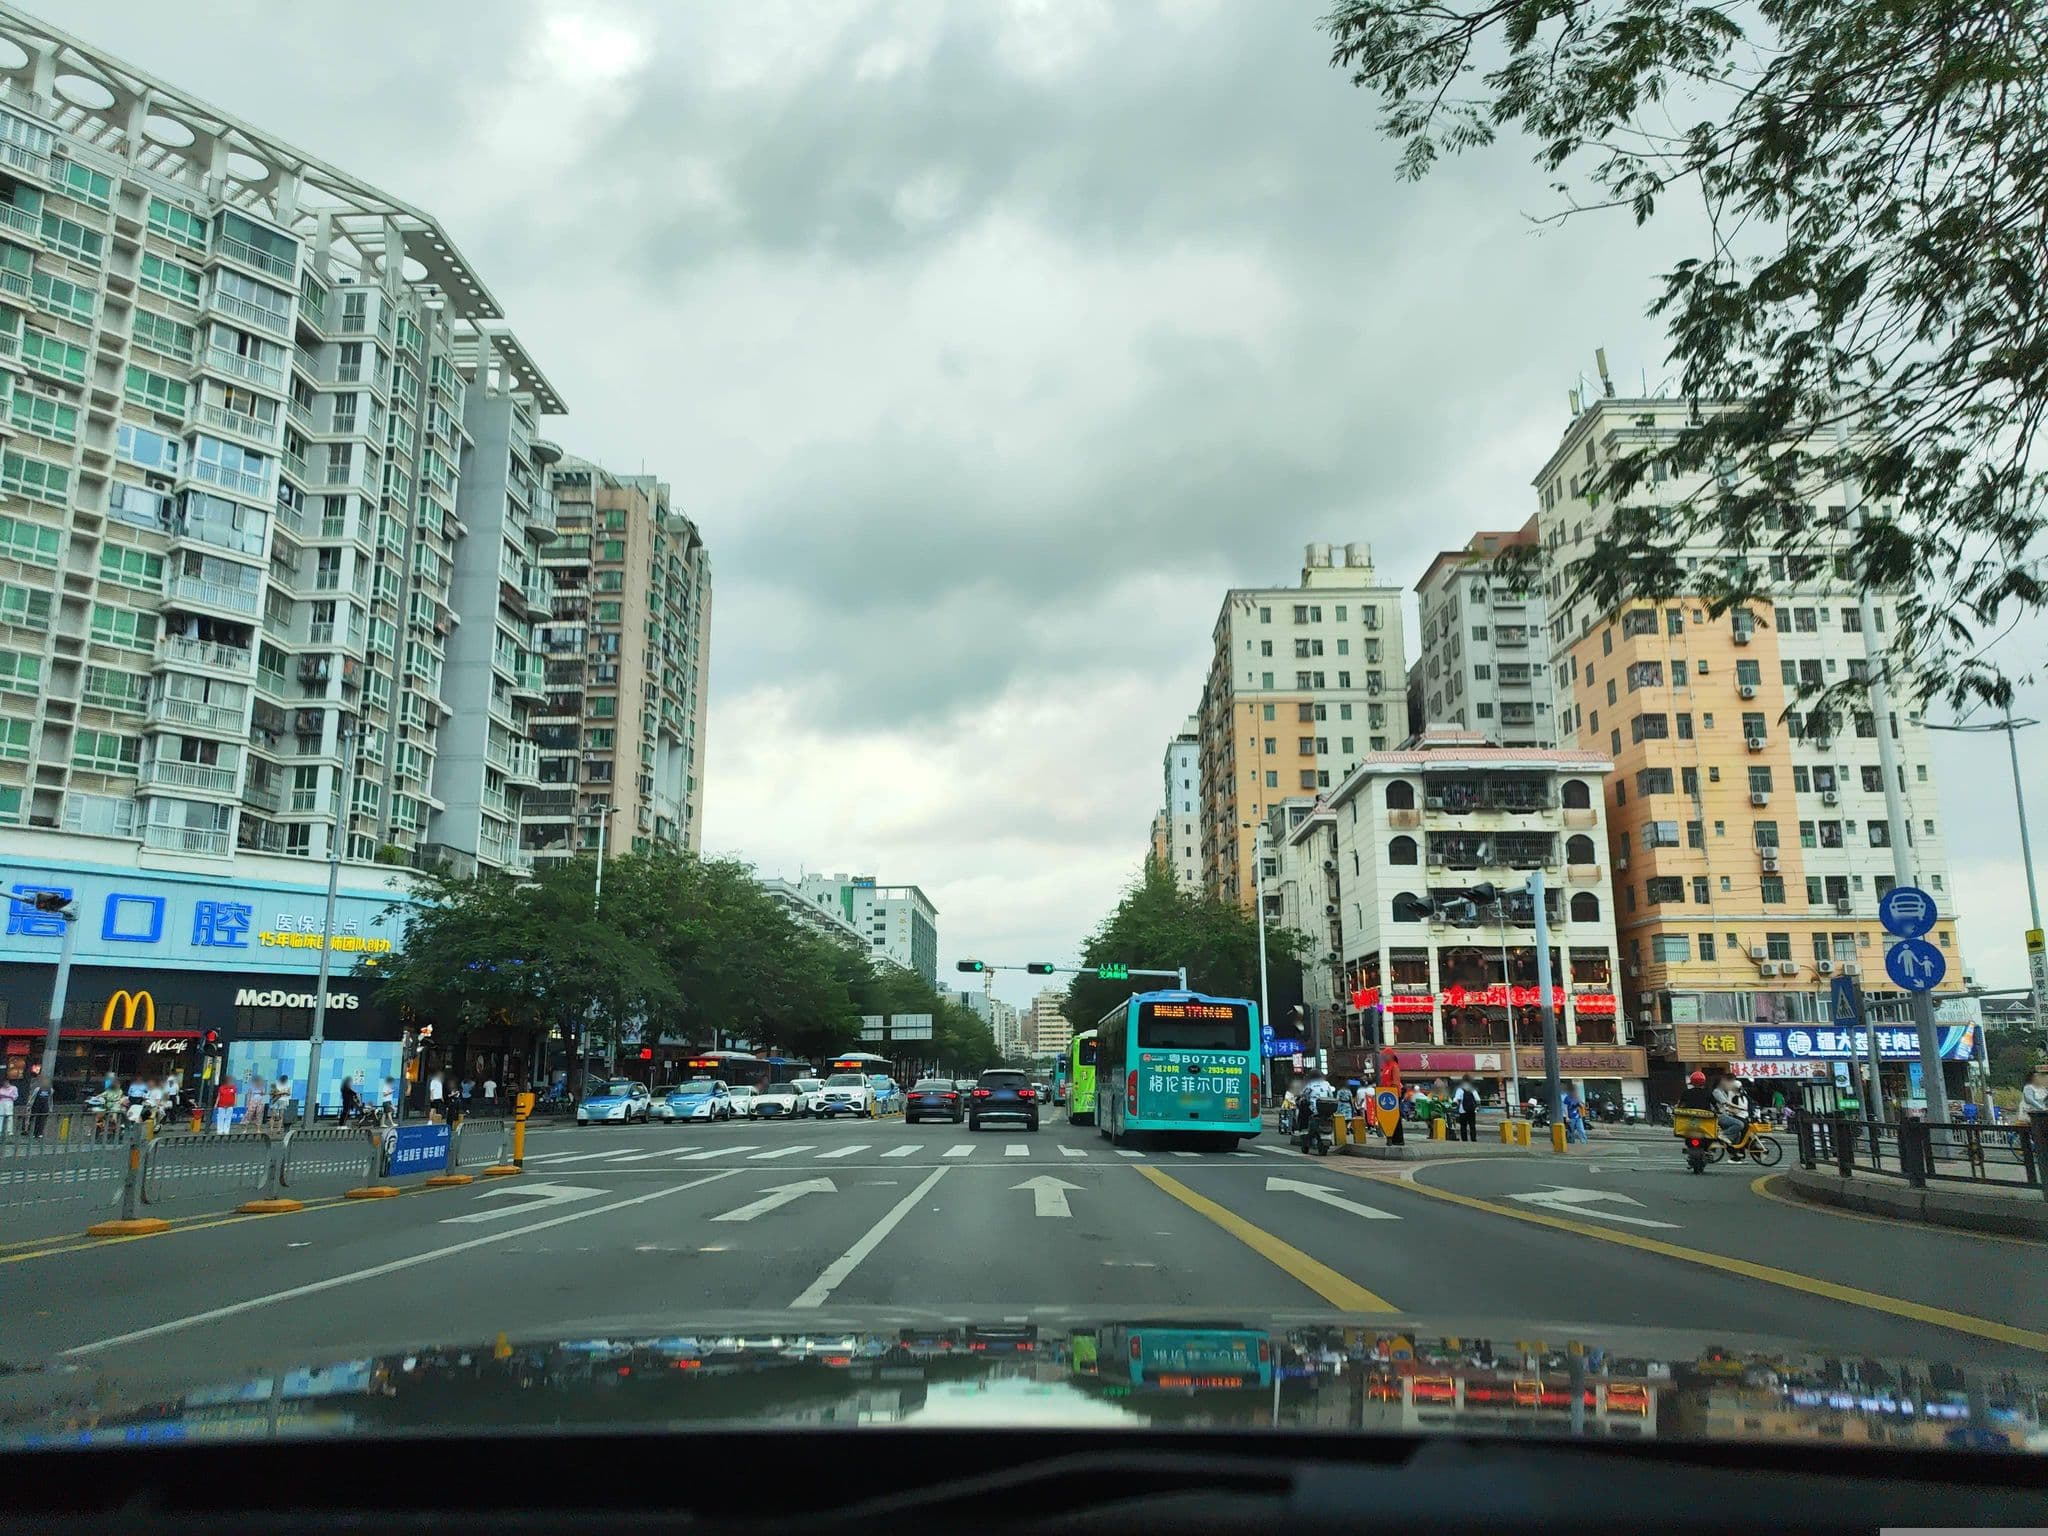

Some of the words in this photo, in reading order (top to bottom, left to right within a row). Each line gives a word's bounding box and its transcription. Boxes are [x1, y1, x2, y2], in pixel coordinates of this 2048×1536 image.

[1278, 1041, 1299, 1052] 牙科
[1702, 1035, 1735, 1052] 住宿
[1149, 1075, 1240, 1094] 格伦菲尔口腔
